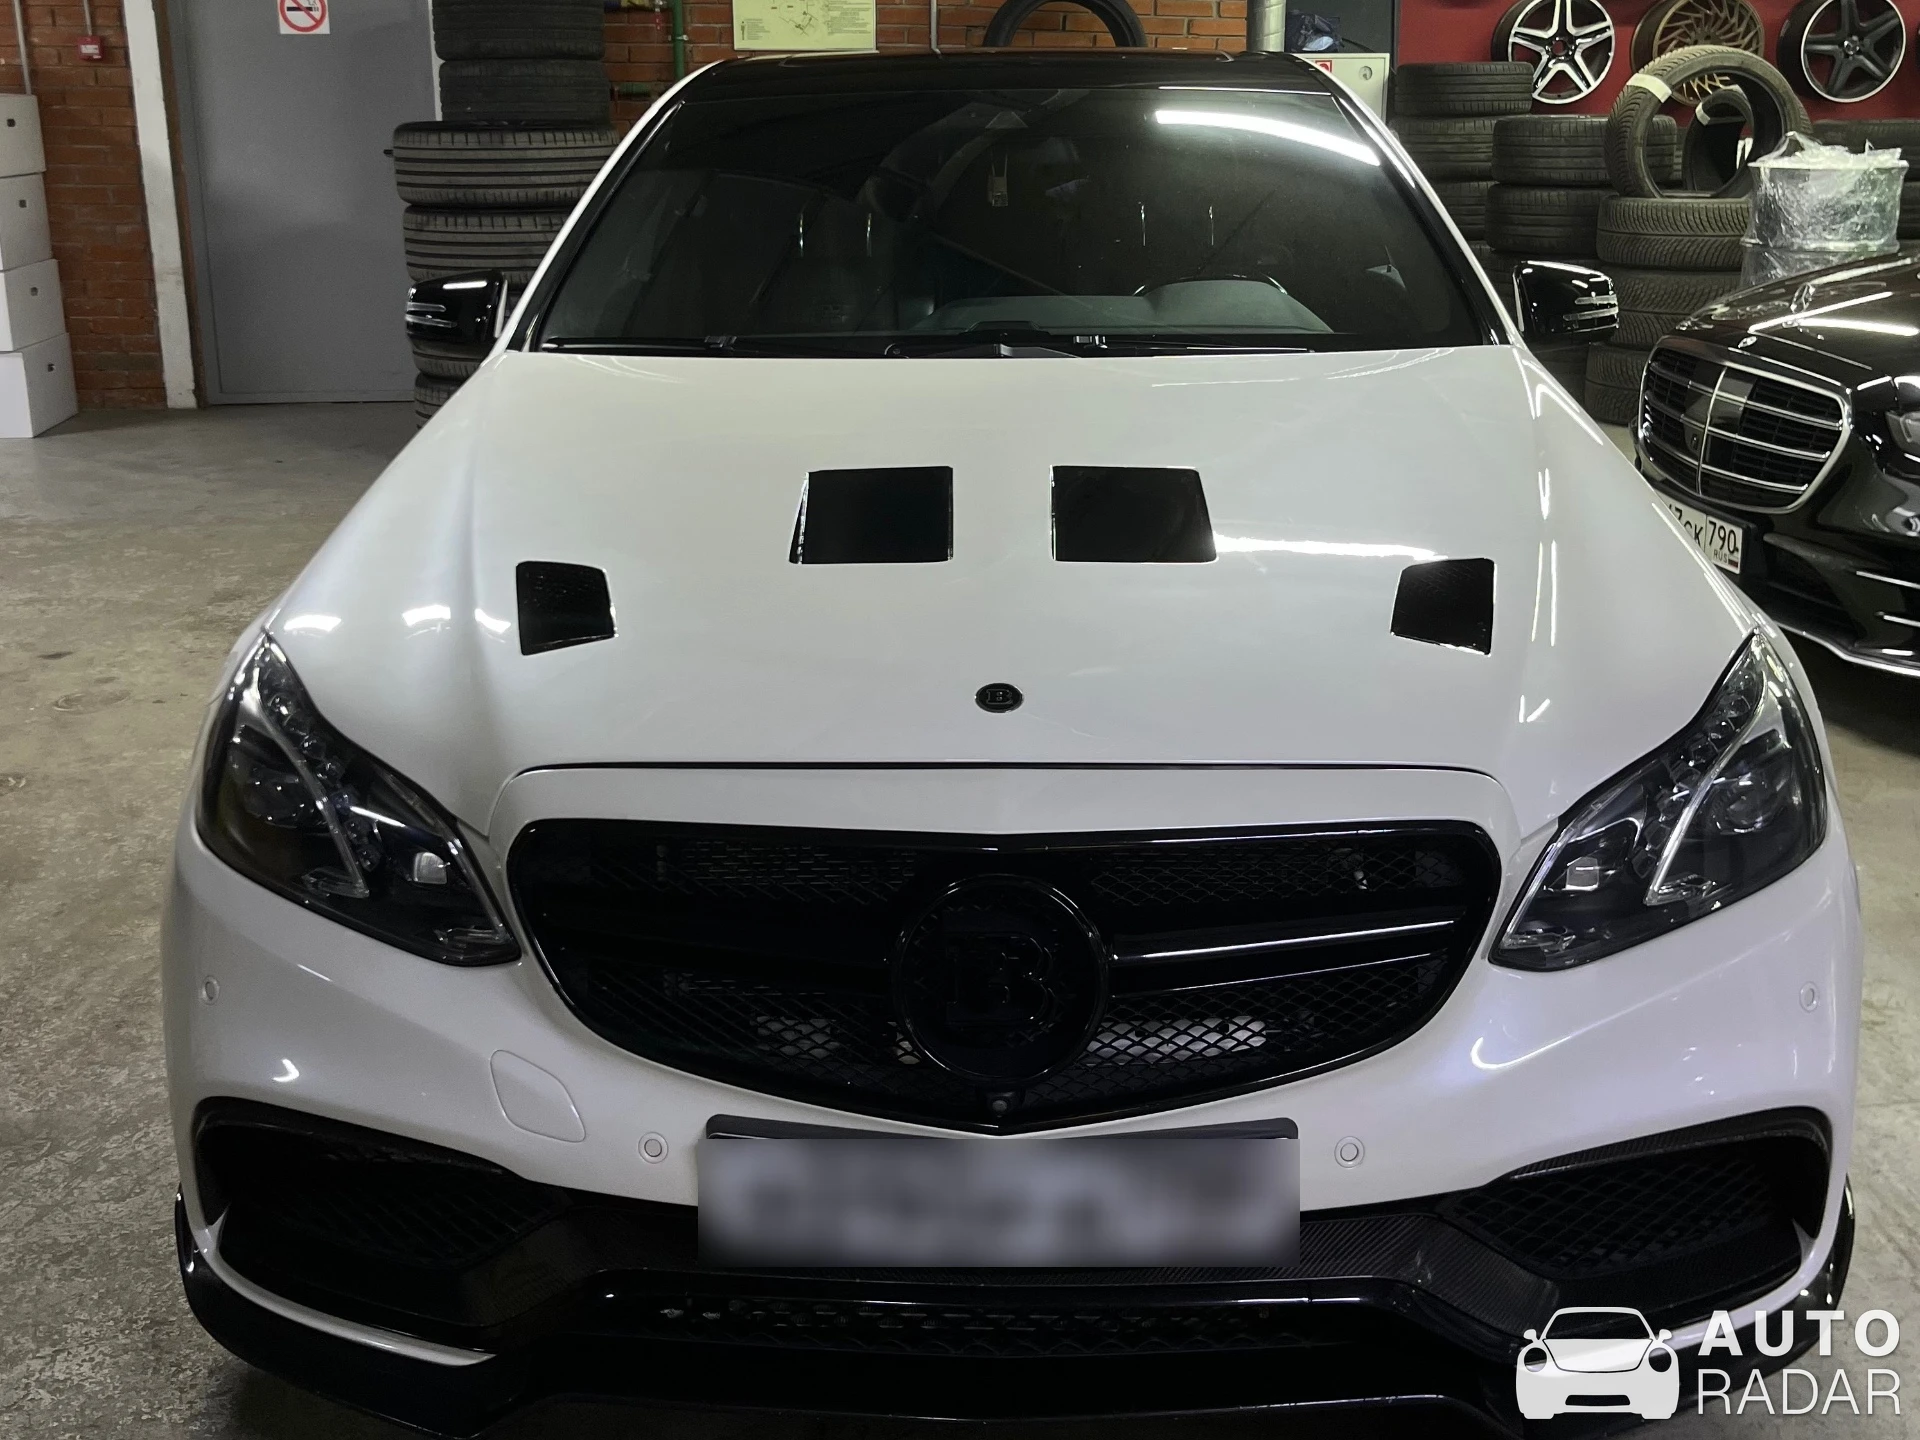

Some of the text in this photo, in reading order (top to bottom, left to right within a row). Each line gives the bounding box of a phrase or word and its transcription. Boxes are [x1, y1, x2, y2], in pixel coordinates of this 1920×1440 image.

[1708, 520, 1736, 554] 790
[1713, 549, 1728, 564] RUS
[986, 688, 1013, 705] B
[944, 931, 1057, 1026] B
